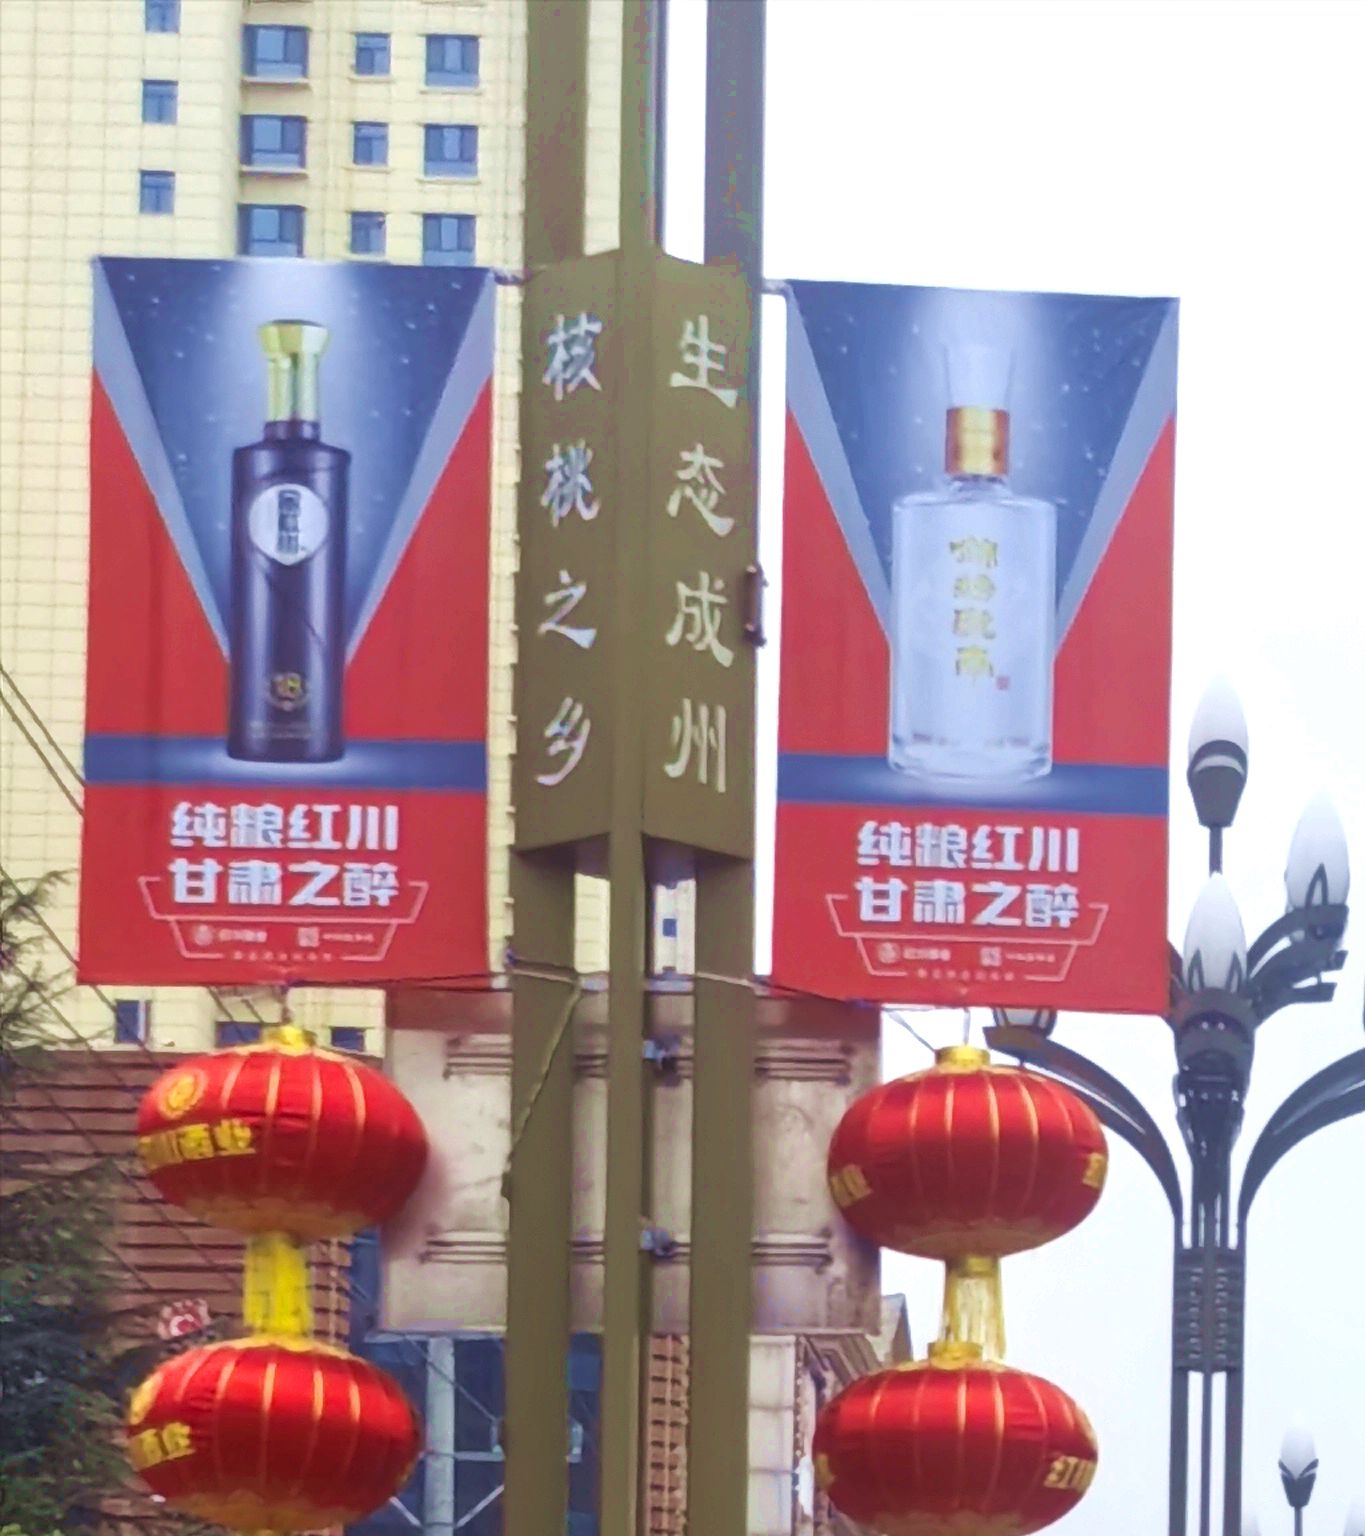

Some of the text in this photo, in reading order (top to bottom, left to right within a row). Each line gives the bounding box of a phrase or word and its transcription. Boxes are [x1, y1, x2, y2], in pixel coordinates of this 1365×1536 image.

[535, 312, 602, 785] 核桃之乡
[664, 314, 737, 793] 生态成州
[170, 802, 399, 850] 纯粮红川
[857, 821, 1079, 872] 纯粮红川
[168, 858, 399, 906] 甘肃之醉
[854, 876, 1079, 928] 甘肃之醉
